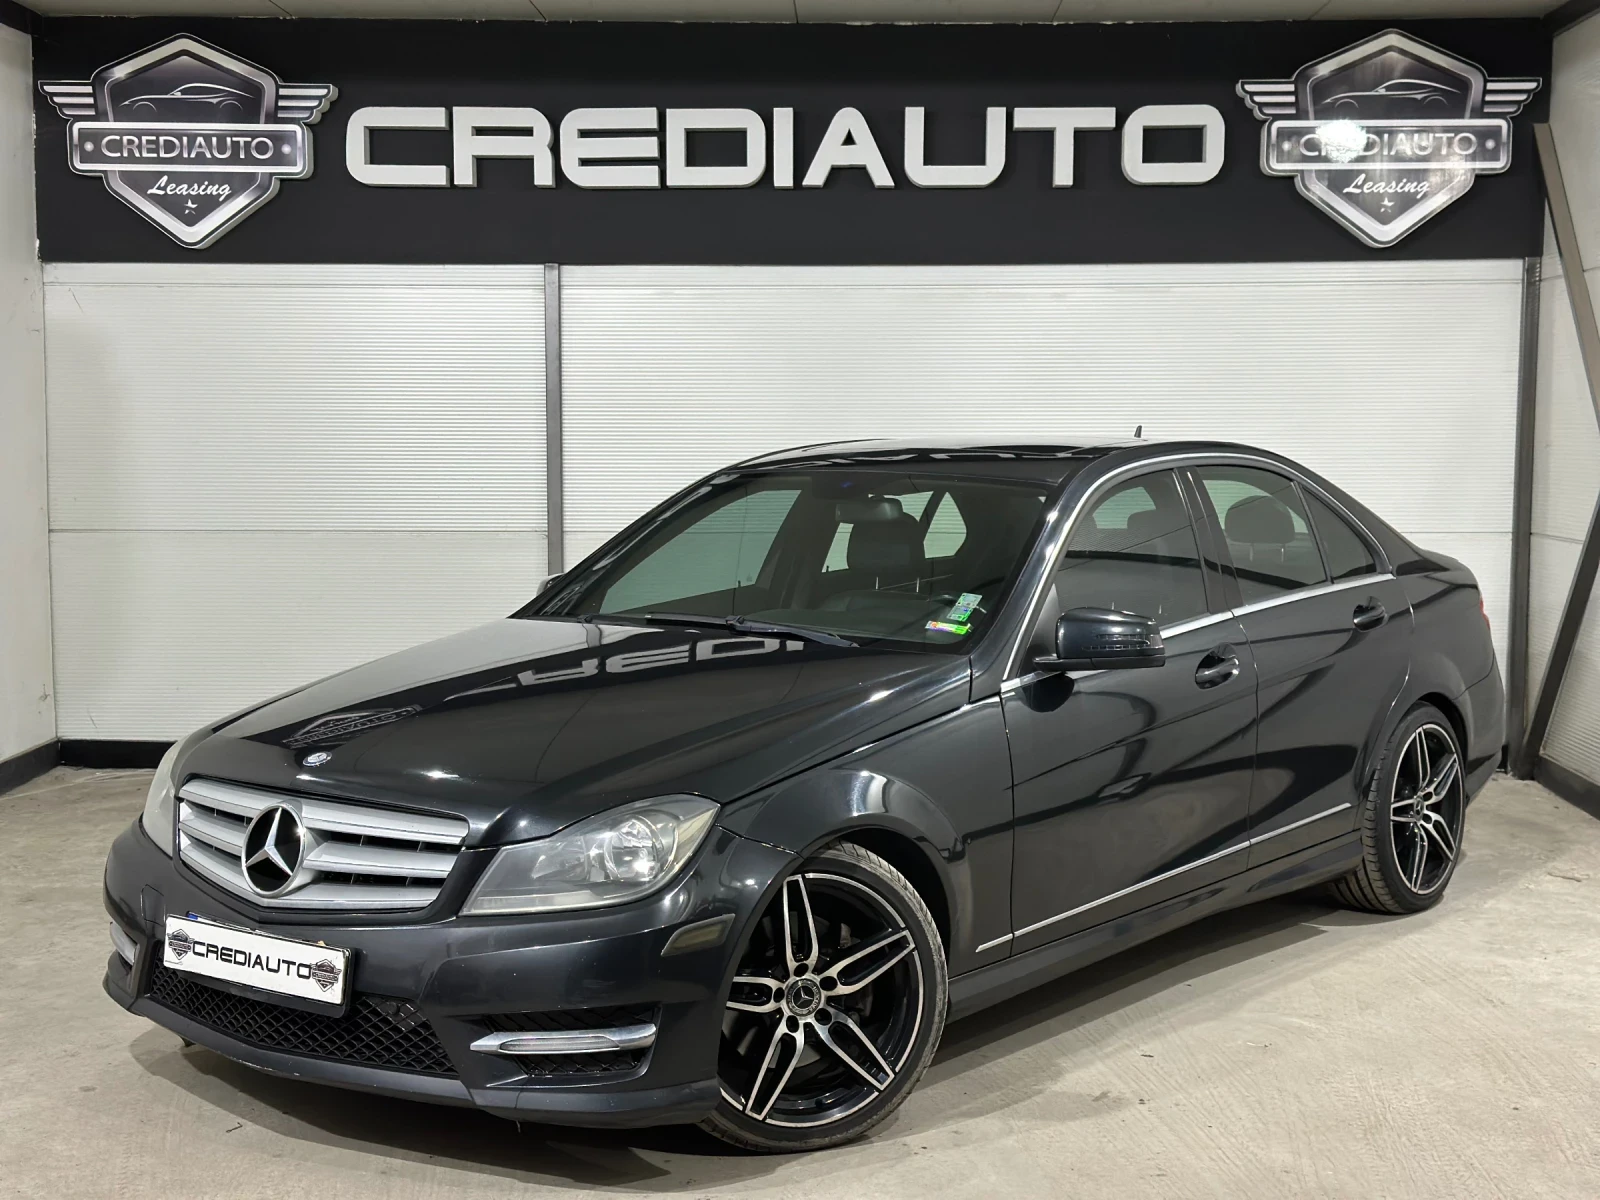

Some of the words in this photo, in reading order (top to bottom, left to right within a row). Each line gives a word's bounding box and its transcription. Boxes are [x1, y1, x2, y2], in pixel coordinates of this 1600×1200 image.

[100, 135, 274, 160] CREDIAUTO
[345, 104, 1225, 187] CREDIAUTO
[1299, 132, 1478, 157] CDIAUTO
[146, 174, 232, 202] Leasing
[1343, 173, 1430, 199] Leasing
[192, 941, 312, 979] CREDIAUTO
